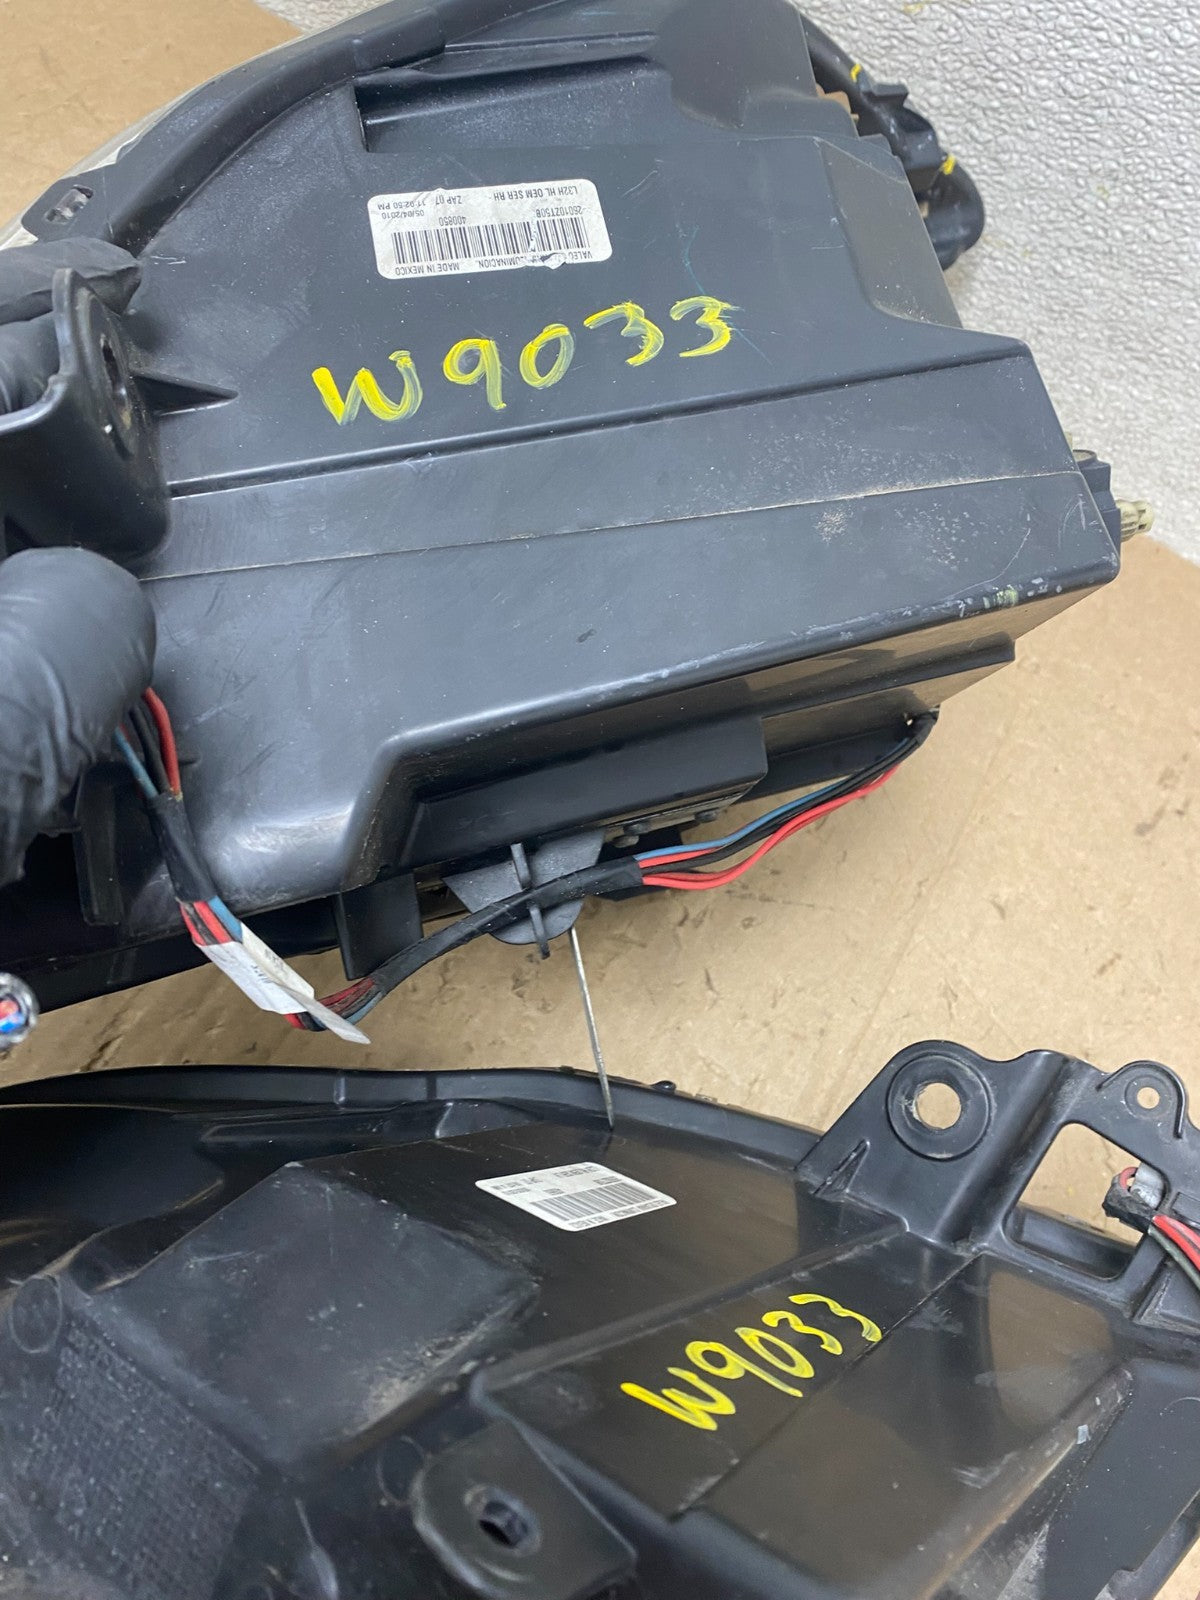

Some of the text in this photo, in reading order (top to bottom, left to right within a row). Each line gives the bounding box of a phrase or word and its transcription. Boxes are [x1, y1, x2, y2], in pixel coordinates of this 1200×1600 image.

[435, 185, 578, 205] L32H HL OEM SER RH ZAP 07
[377, 202, 391, 211] PM
[381, 209, 425, 219] 05/04/2010
[394, 265, 425, 276] MEXICO
[427, 264, 436, 273] IN
[438, 262, 460, 272] MADE
[311, 296, 736, 425] W9033
[620, 1293, 882, 1431] W9033
